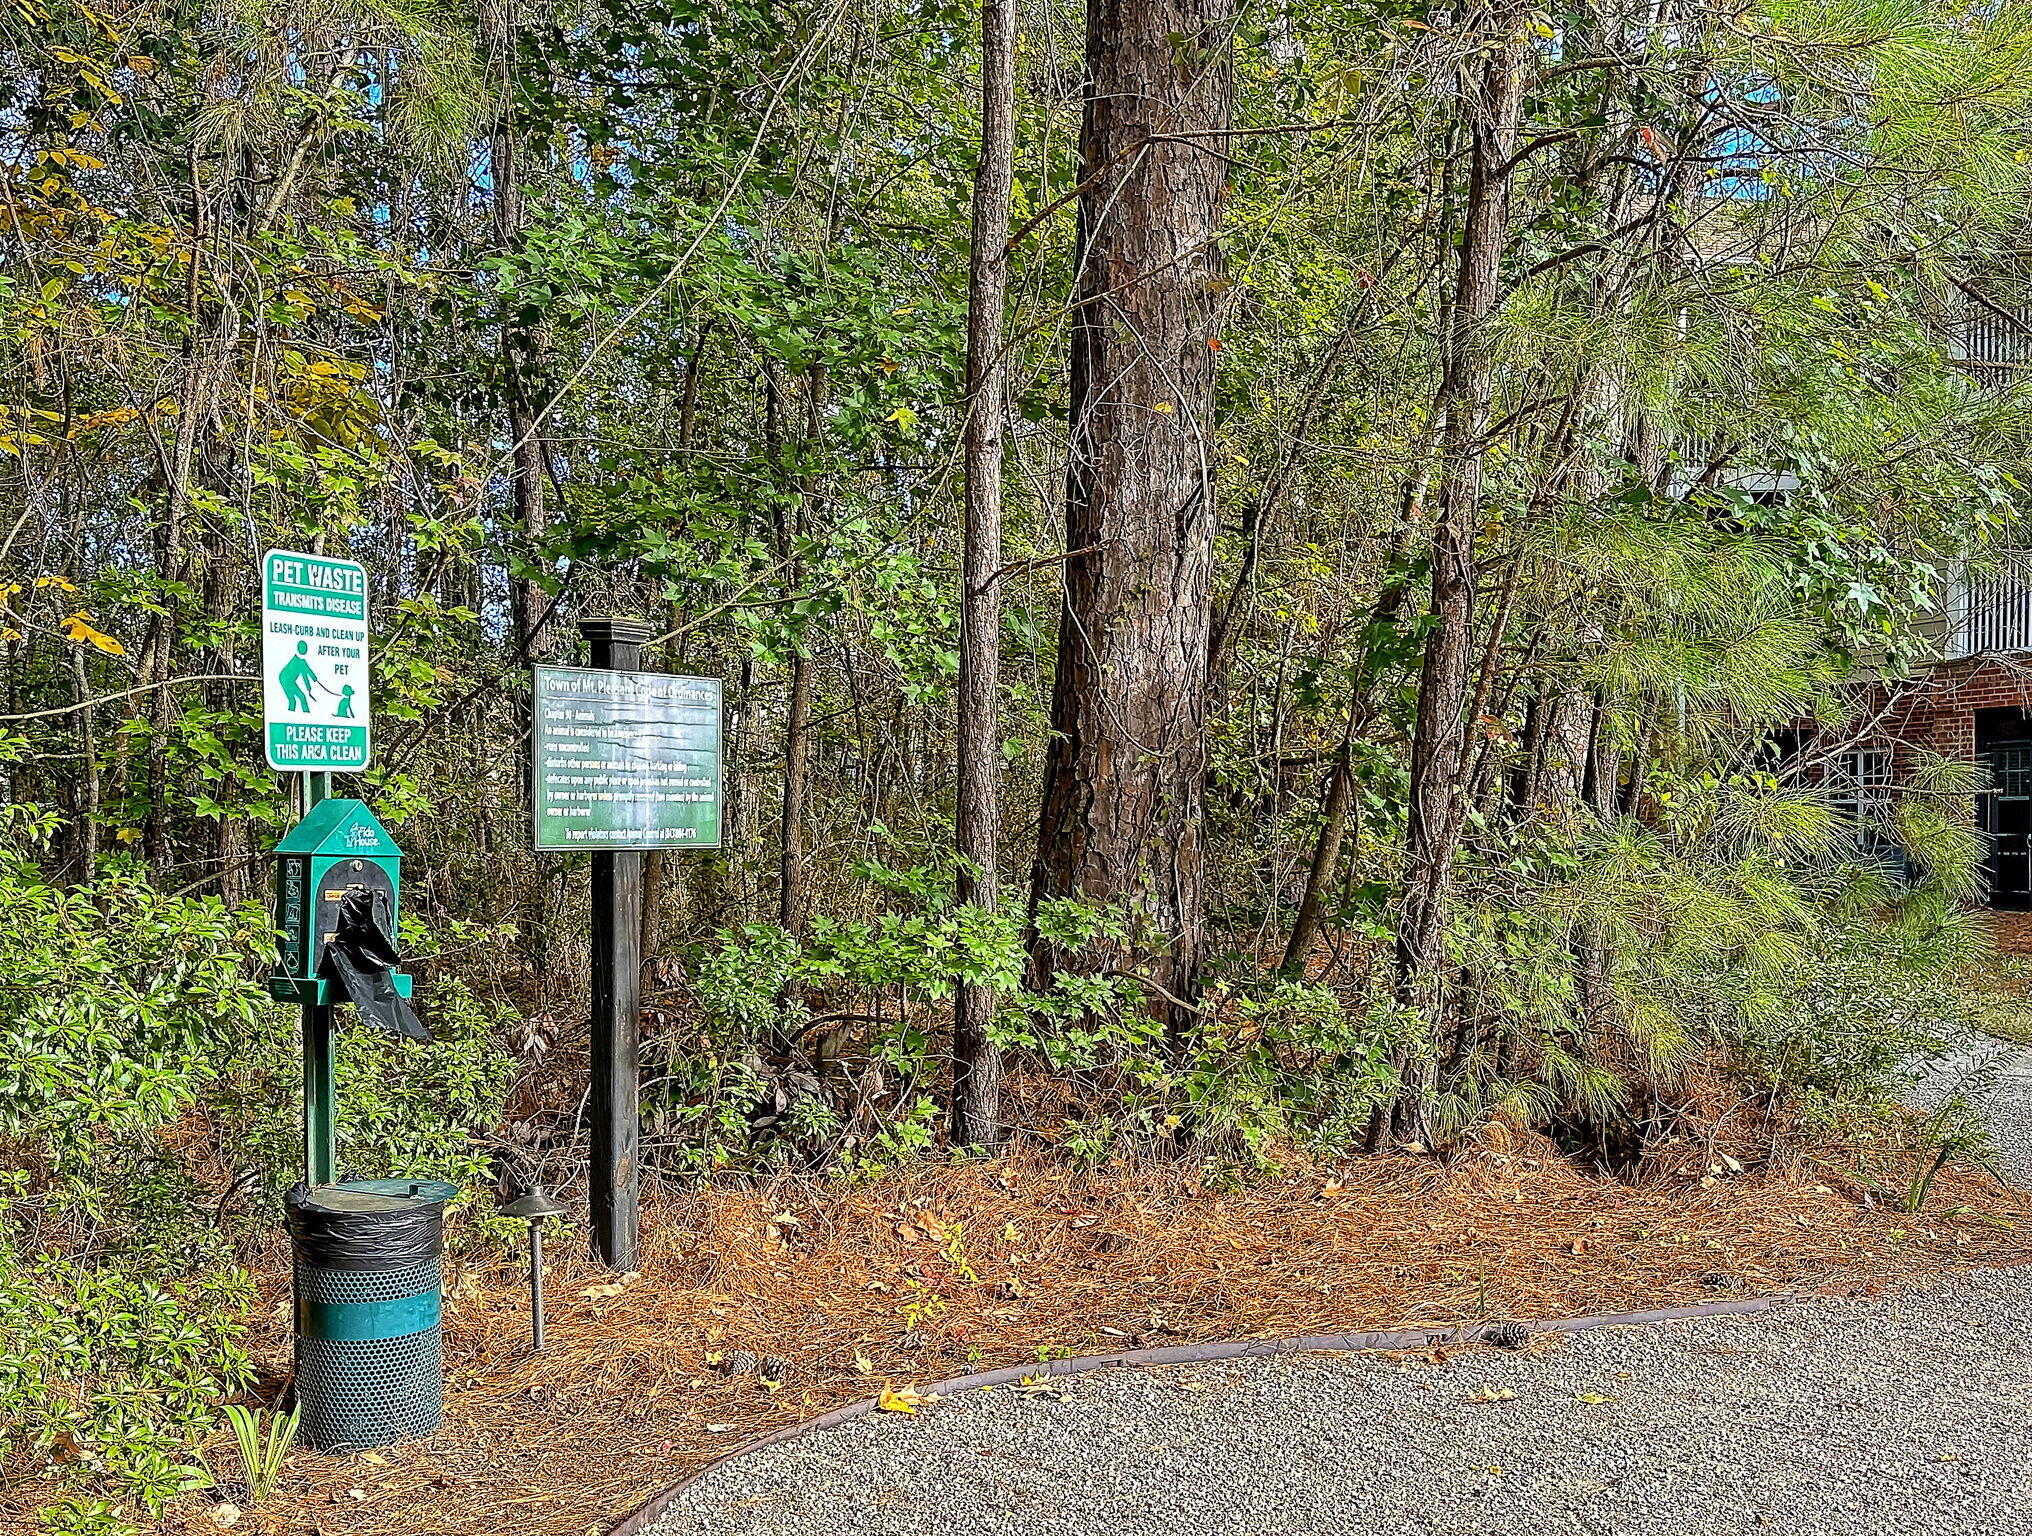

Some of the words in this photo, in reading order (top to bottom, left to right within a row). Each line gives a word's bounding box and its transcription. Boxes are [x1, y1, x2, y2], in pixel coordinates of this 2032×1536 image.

[272, 558, 303, 584] PET
[308, 563, 363, 593] WASTE
[273, 590, 324, 612] TRANSMITS
[325, 596, 362, 616] DISEASE
[316, 627, 330, 639] AND
[332, 628, 354, 641] CLEAN
[355, 631, 365, 642] UP
[317, 645, 340, 657] AFTER
[341, 647, 361, 659] YOUR
[334, 664, 349, 675] PET
[544, 676, 570, 692] Town
[571, 678, 580, 693] of
[582, 678, 597, 694] Mt.
[658, 684, 667, 697] of
[668, 685, 713, 702] Ordinances
[286, 726, 324, 743] PLEASE
[325, 727, 352, 744] KEEP
[275, 743, 299, 760] THIS
[301, 744, 327, 761] AREA
[330, 745, 362, 761] CLEAN
